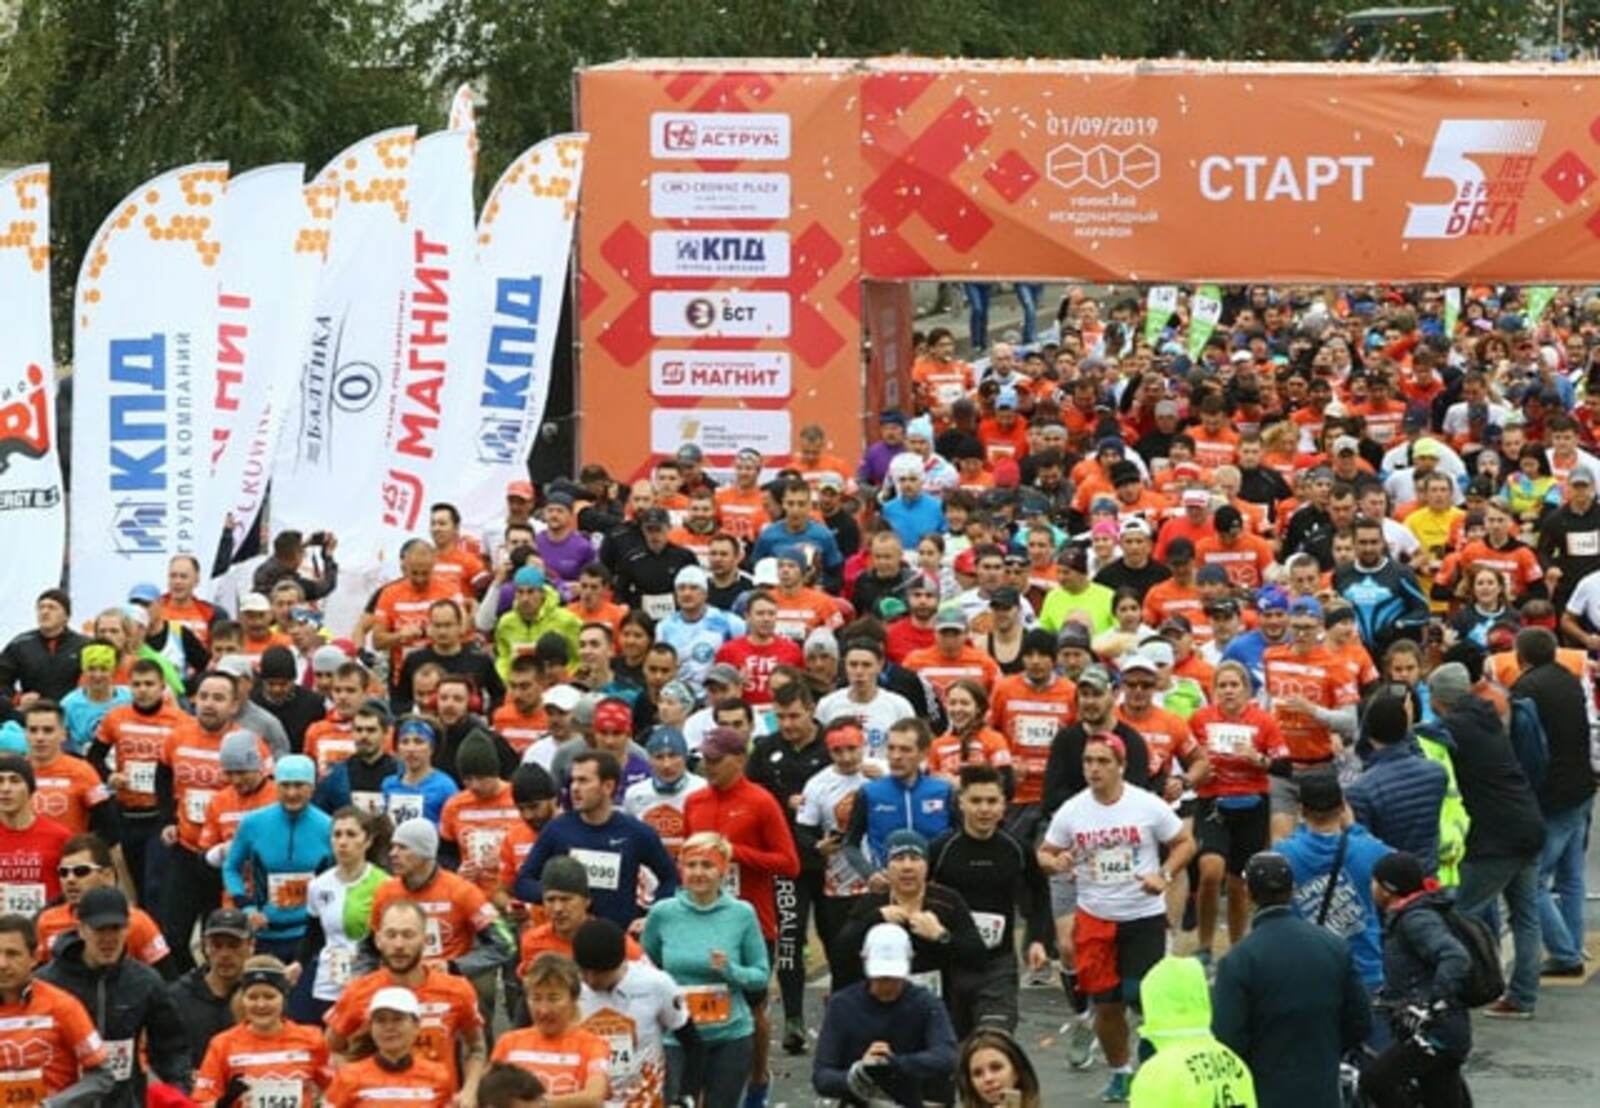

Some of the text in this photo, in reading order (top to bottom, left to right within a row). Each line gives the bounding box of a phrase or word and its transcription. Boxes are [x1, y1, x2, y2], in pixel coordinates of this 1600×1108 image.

[1046, 116, 1159, 136] 01/09/2019
[1199, 155, 1375, 202] СТАРТ
[1498, 156, 1538, 179] ЛЕТ
[1445, 201, 1520, 236] БЕГА
[702, 236, 766, 261] КПД
[722, 306, 757, 321] БСТ
[395, 230, 451, 460] МАГНИТ
[480, 275, 541, 410] КПД
[303, 314, 334, 442] БАЛТИКА
[691, 370, 779, 385] МАГНИТ
[109, 332, 167, 491] КПД
[176, 468, 194, 556] ГРУППА
